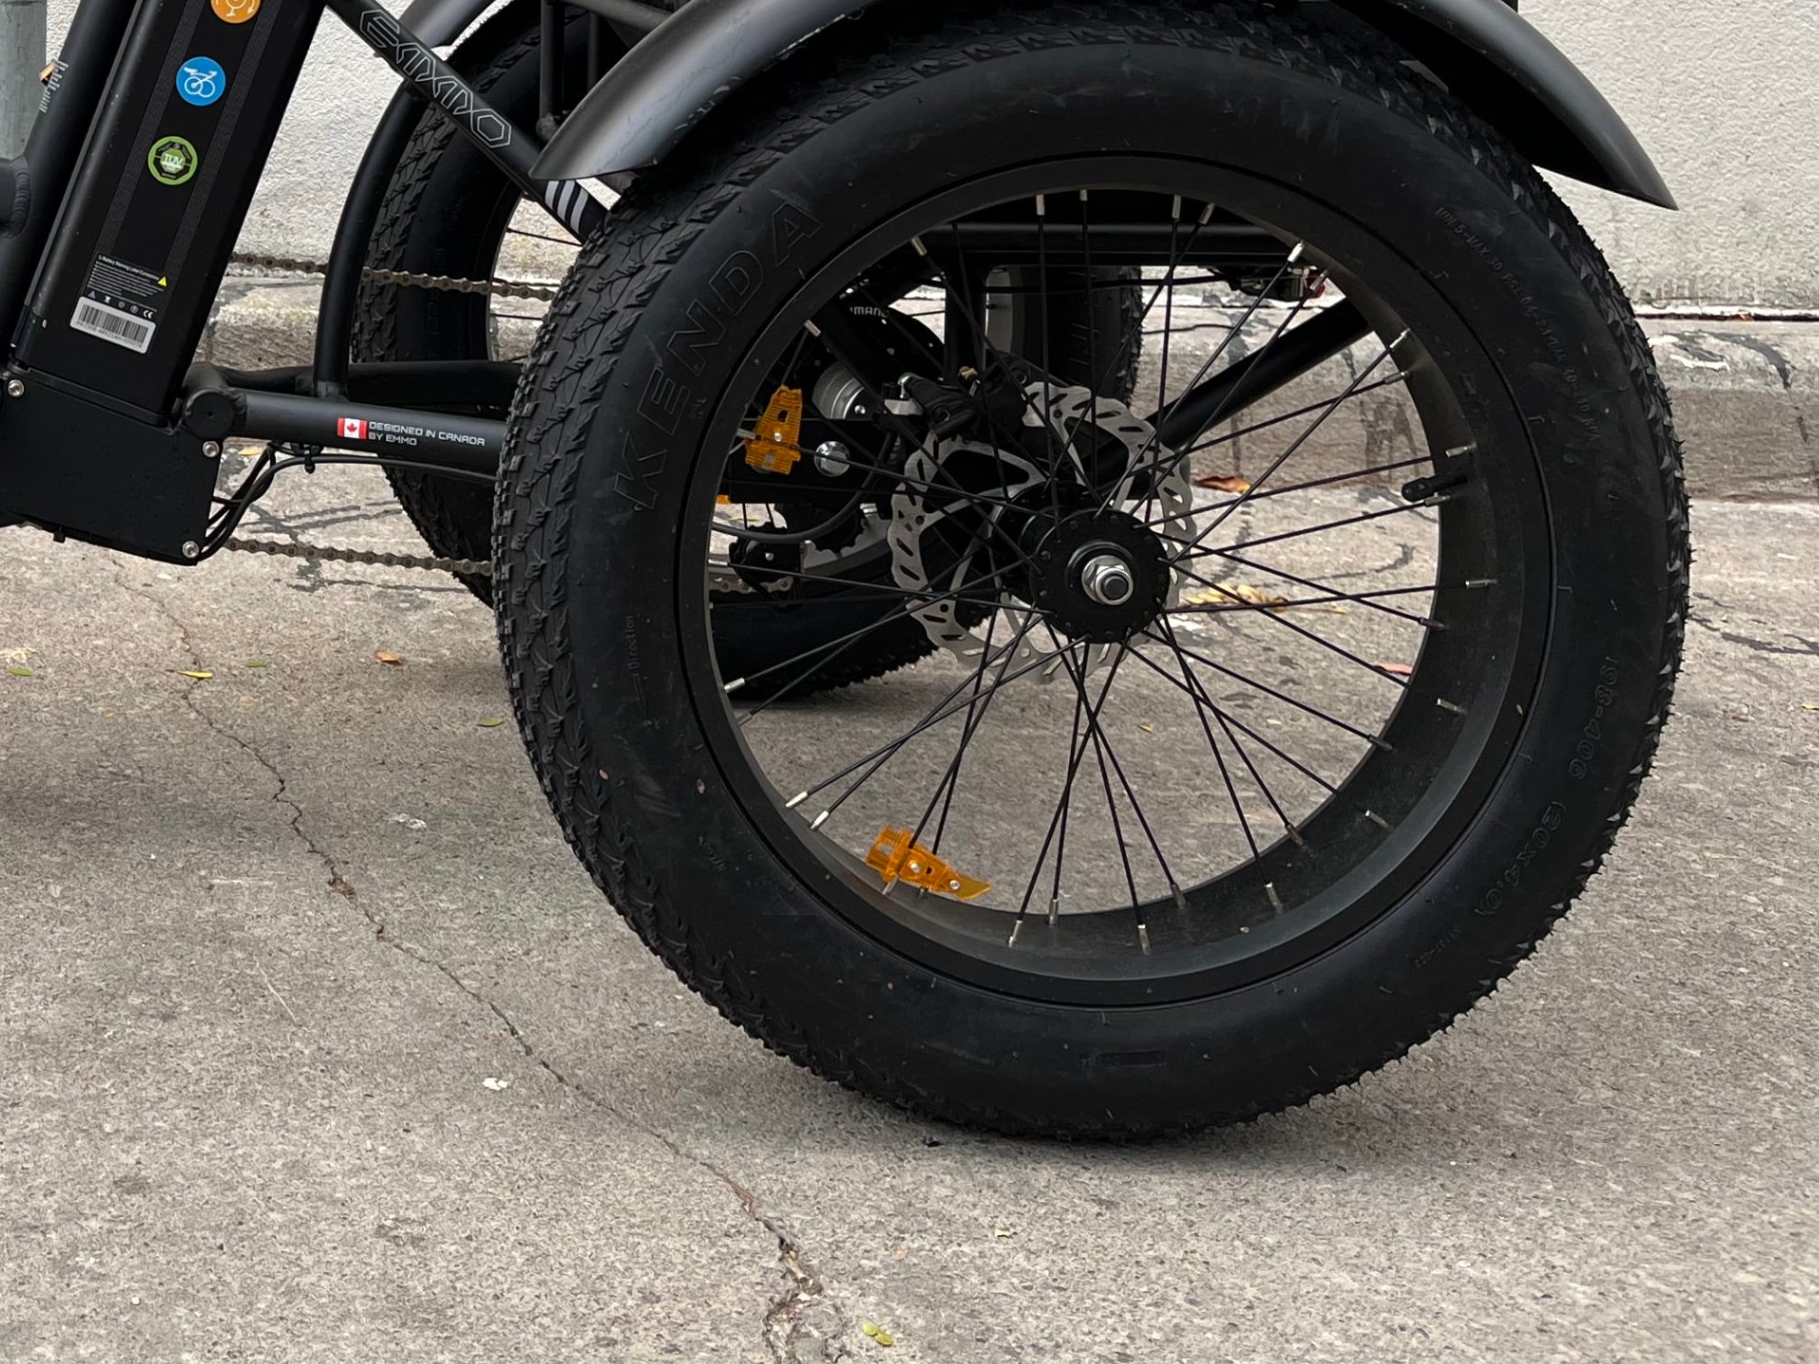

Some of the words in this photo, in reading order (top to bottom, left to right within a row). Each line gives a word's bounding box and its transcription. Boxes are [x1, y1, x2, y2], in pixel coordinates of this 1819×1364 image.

[360, 9, 512, 148] EMMO
[614, 201, 824, 510] KENDA
[369, 421, 423, 436] DESIGNED
[425, 429, 436, 438] IN
[438, 431, 485, 446] CANADA
[369, 432, 383, 440] BY
[385, 435, 417, 446] EMMO
[624, 615, 641, 674] Direction
